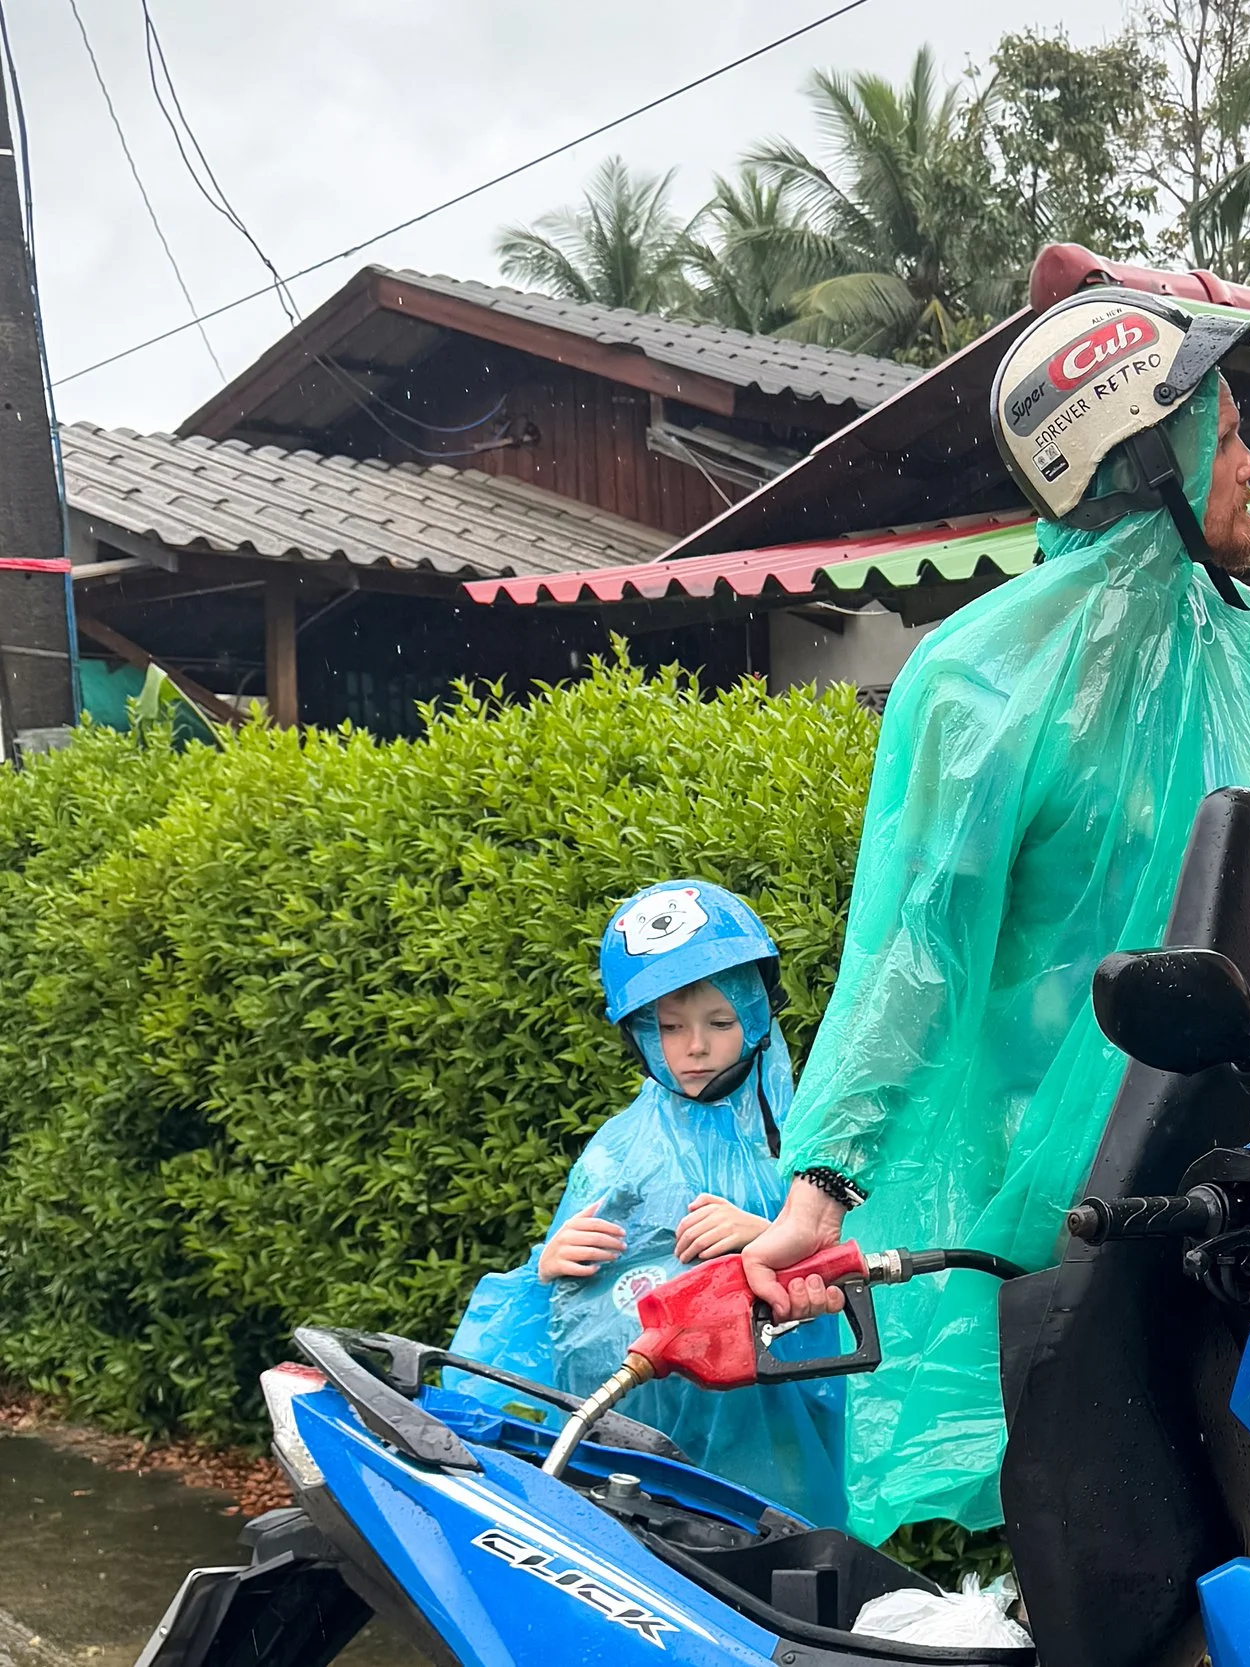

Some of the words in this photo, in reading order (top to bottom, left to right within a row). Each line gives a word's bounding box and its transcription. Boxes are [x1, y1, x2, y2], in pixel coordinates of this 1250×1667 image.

[1091, 315, 1105, 326] ALL
[1106, 307, 1123, 319] NEW
[1011, 379, 1047, 427] Super
[1062, 322, 1144, 380] Cub
[1034, 398, 1091, 448] FOREVER
[1093, 353, 1162, 400] RETRO
[474, 1530, 674, 1645] CLICK
